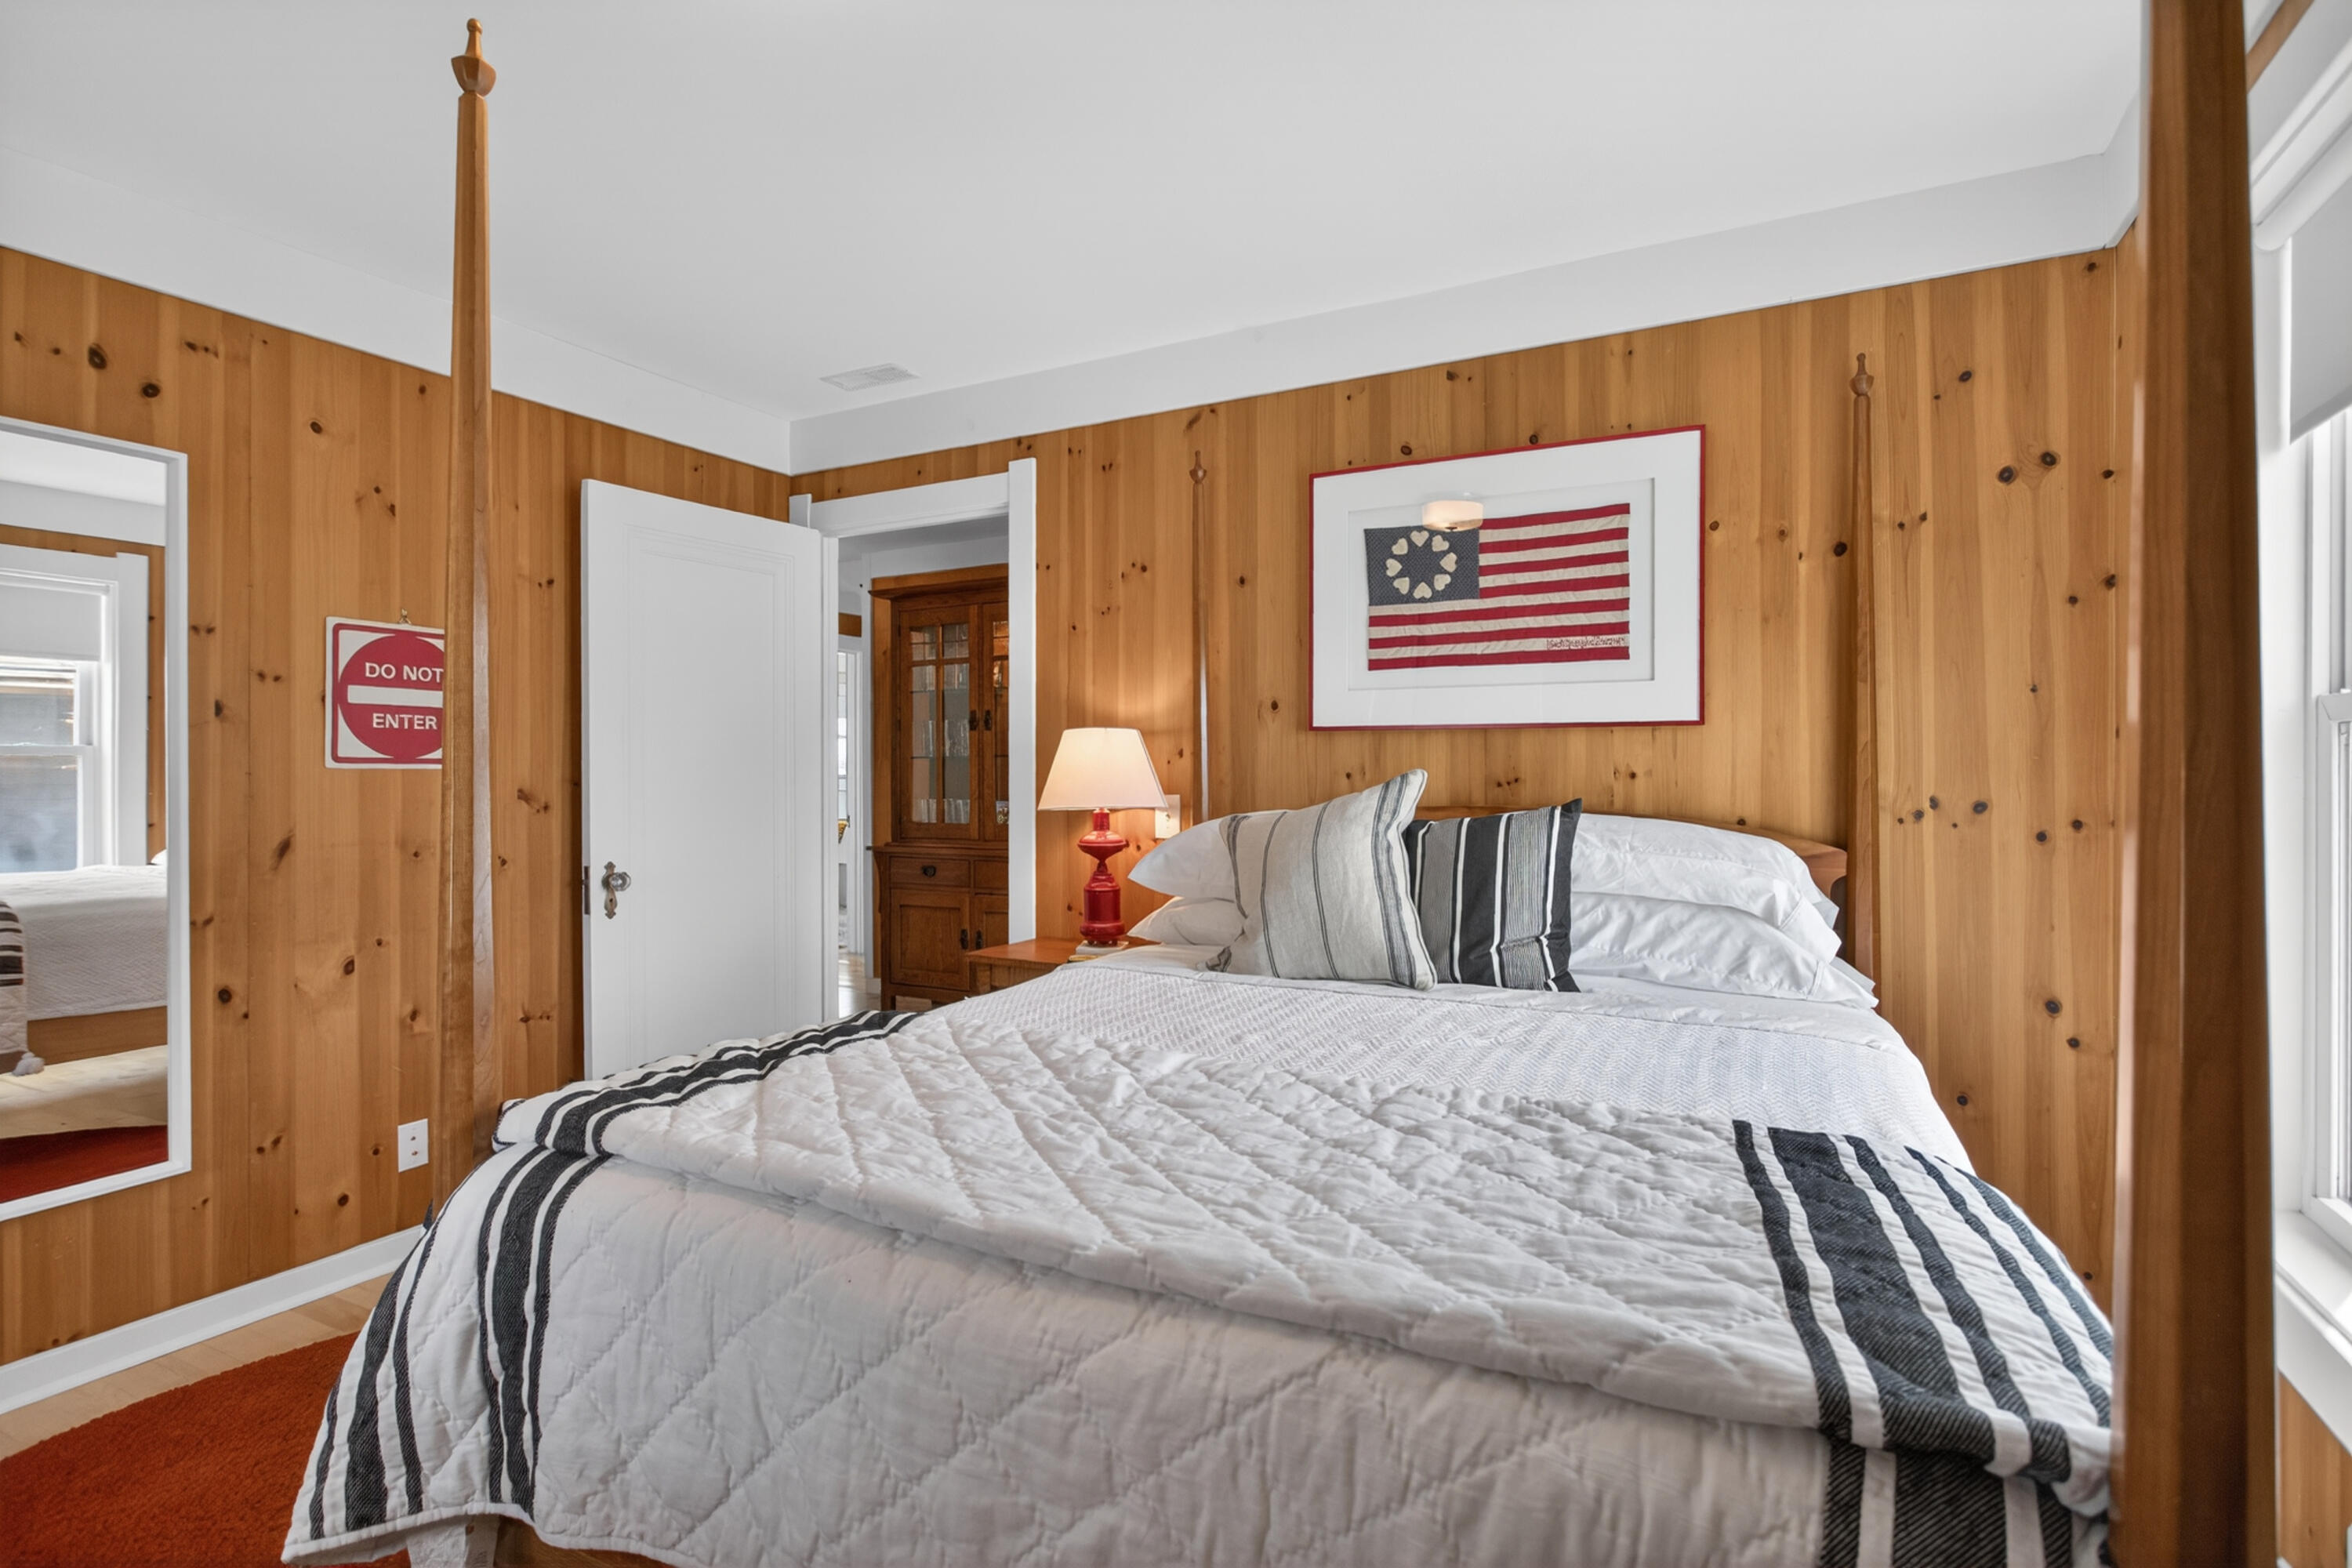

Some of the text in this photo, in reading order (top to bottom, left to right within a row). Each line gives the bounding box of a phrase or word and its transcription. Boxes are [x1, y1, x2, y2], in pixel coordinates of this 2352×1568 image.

[365, 662, 445, 683] DO NOT
[372, 713, 437, 730] ENTER
